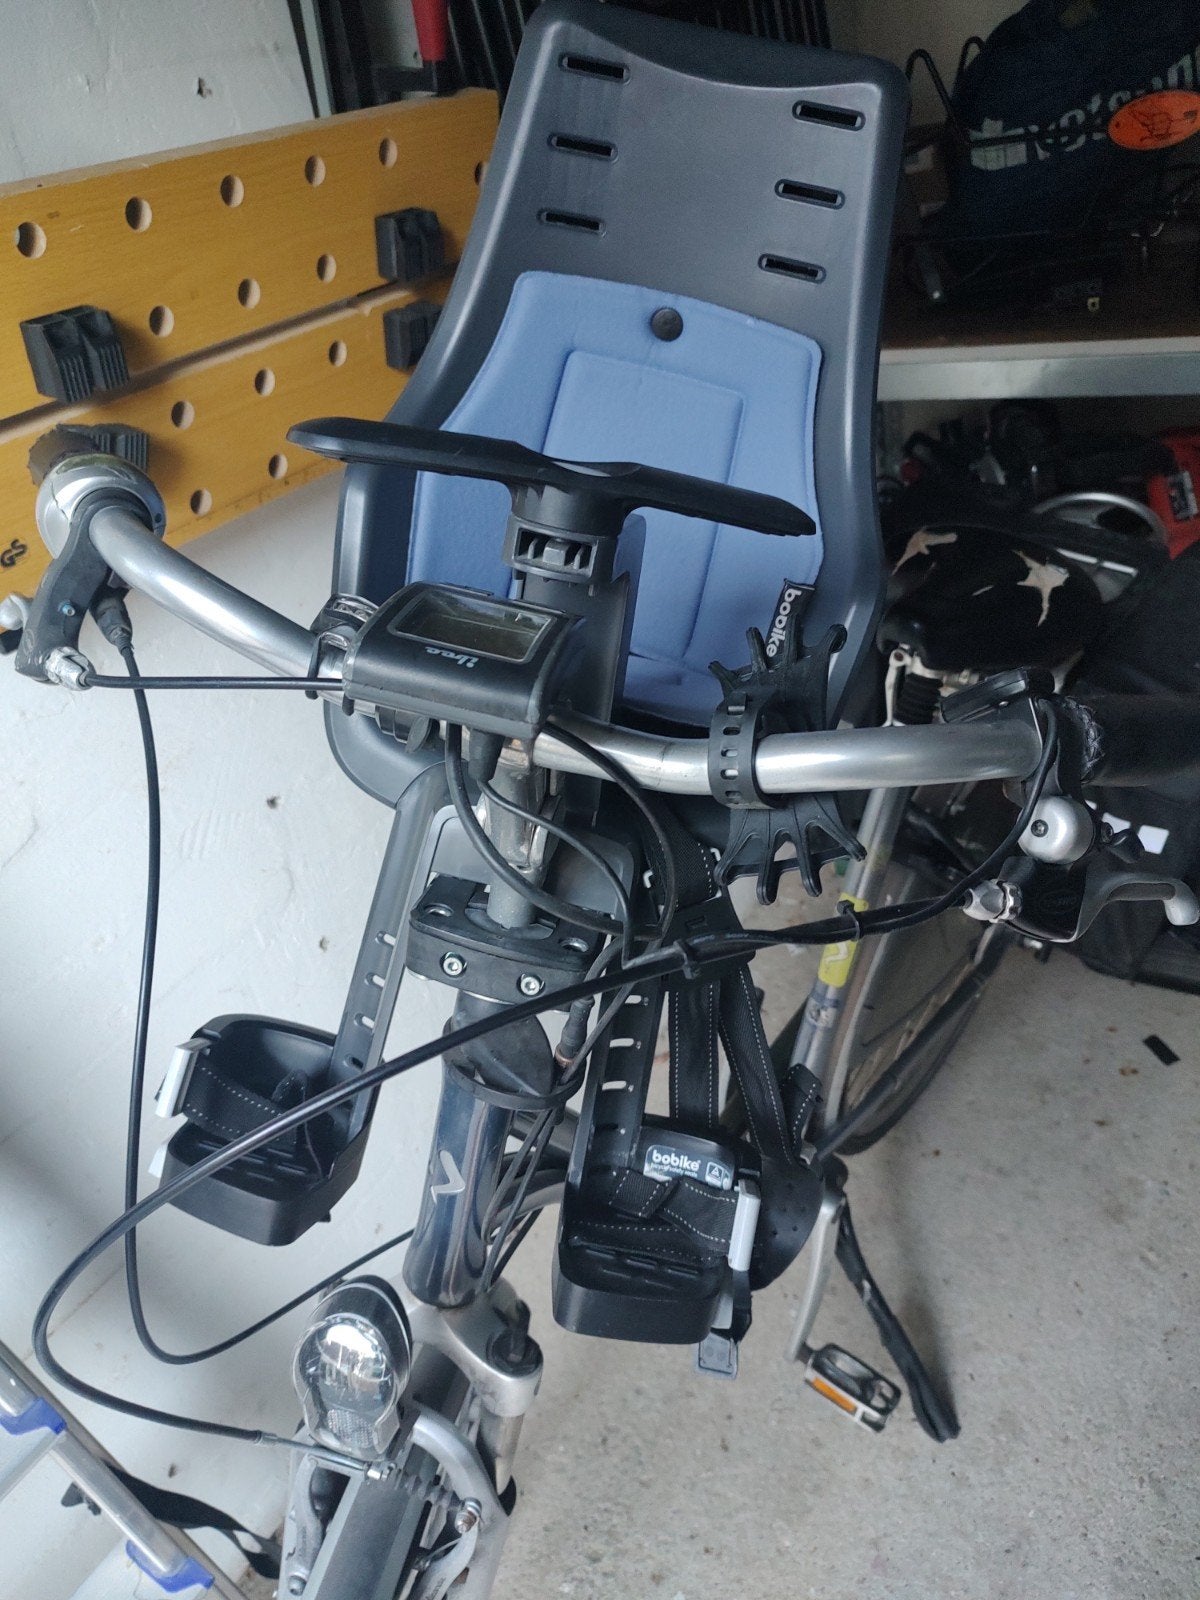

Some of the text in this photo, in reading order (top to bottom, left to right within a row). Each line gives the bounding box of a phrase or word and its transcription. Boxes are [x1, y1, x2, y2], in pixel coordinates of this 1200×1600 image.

[0, 538, 27, 567] GS
[766, 588, 802, 657] bobike
[652, 1149, 700, 1171] bobike
